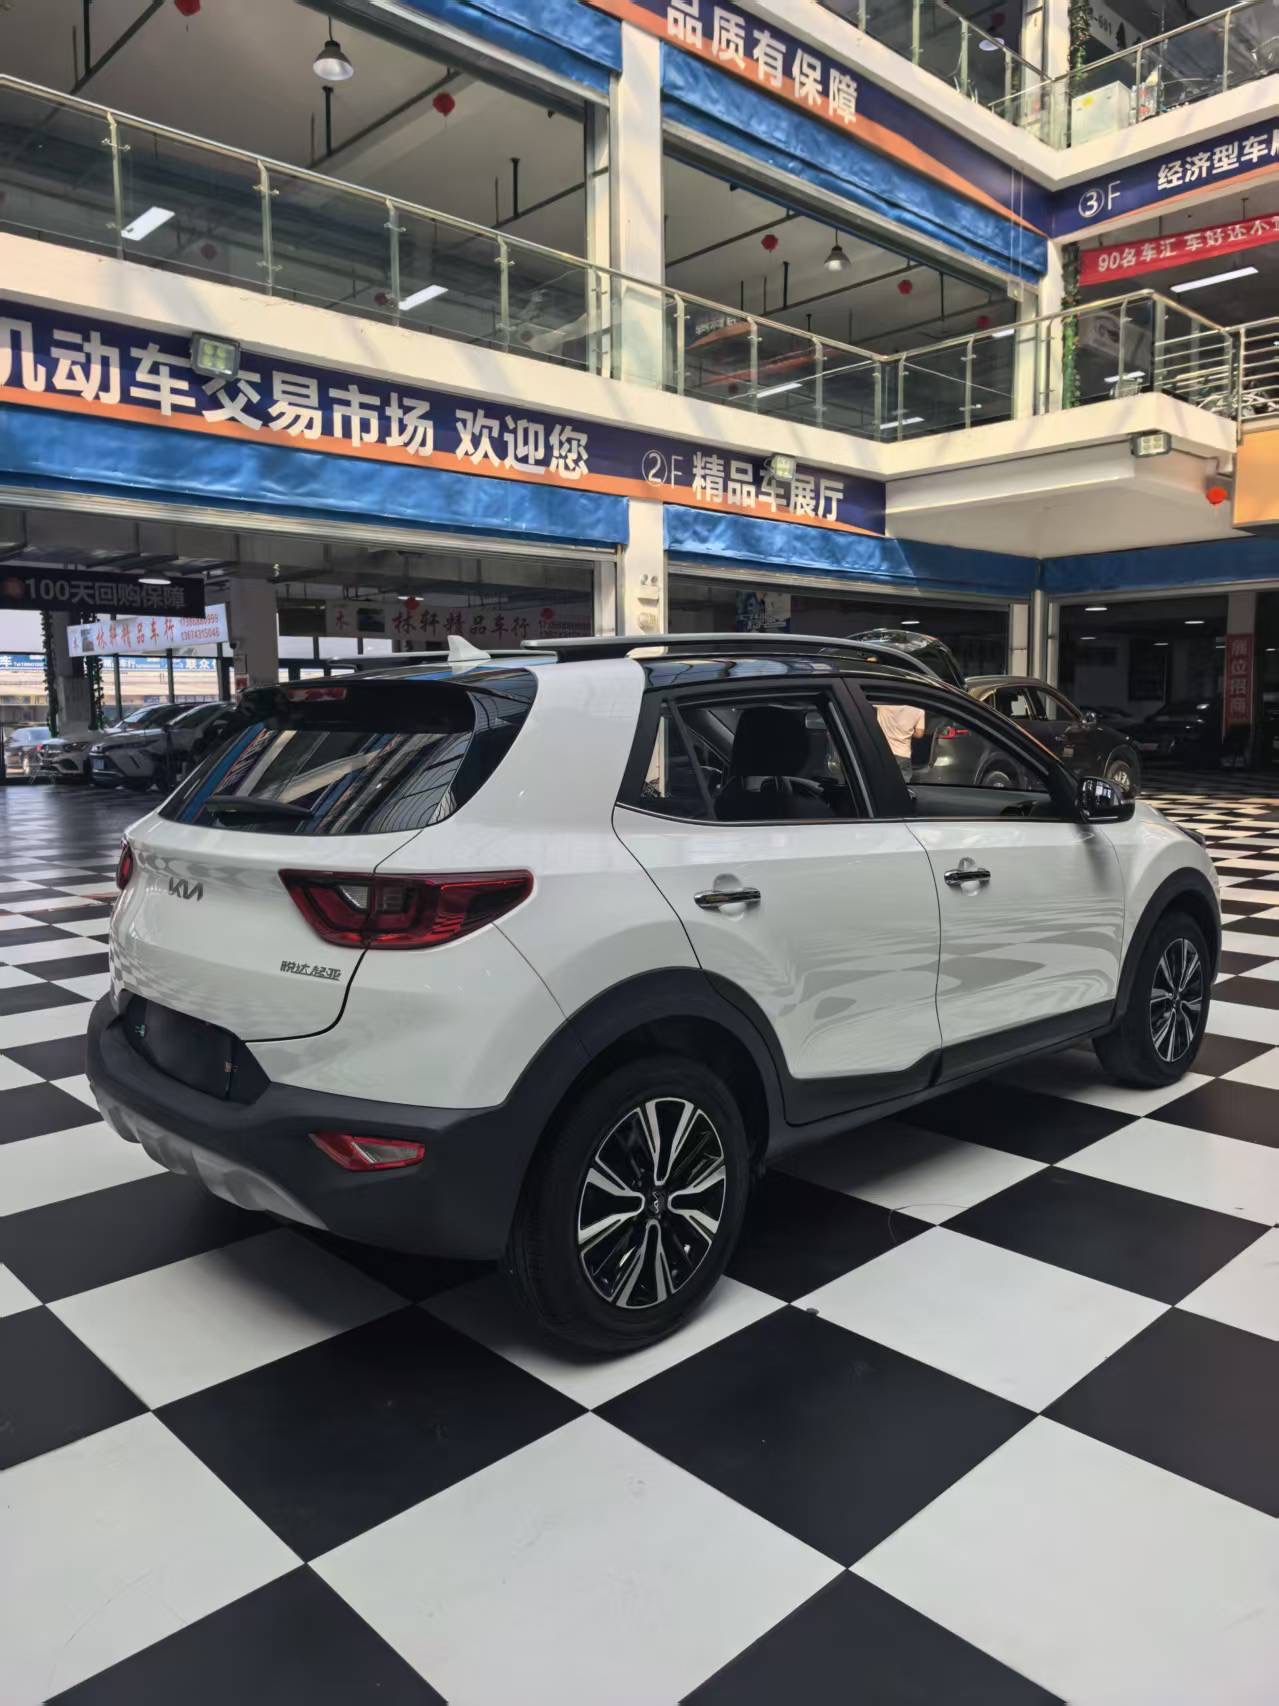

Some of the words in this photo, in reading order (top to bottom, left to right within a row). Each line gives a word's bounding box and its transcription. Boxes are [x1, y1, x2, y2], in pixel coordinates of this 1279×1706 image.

[667, 0, 858, 124] 品质有保障
[1098, 238, 1177, 272] 90名车汇
[455, 408, 589, 480] 欢迎您
[693, 451, 844, 521] 精品车展厅
[25, 578, 185, 608] 100天回购保障
[169, 877, 204, 901] KIA
[280, 960, 342, 981] 悦达起亚
